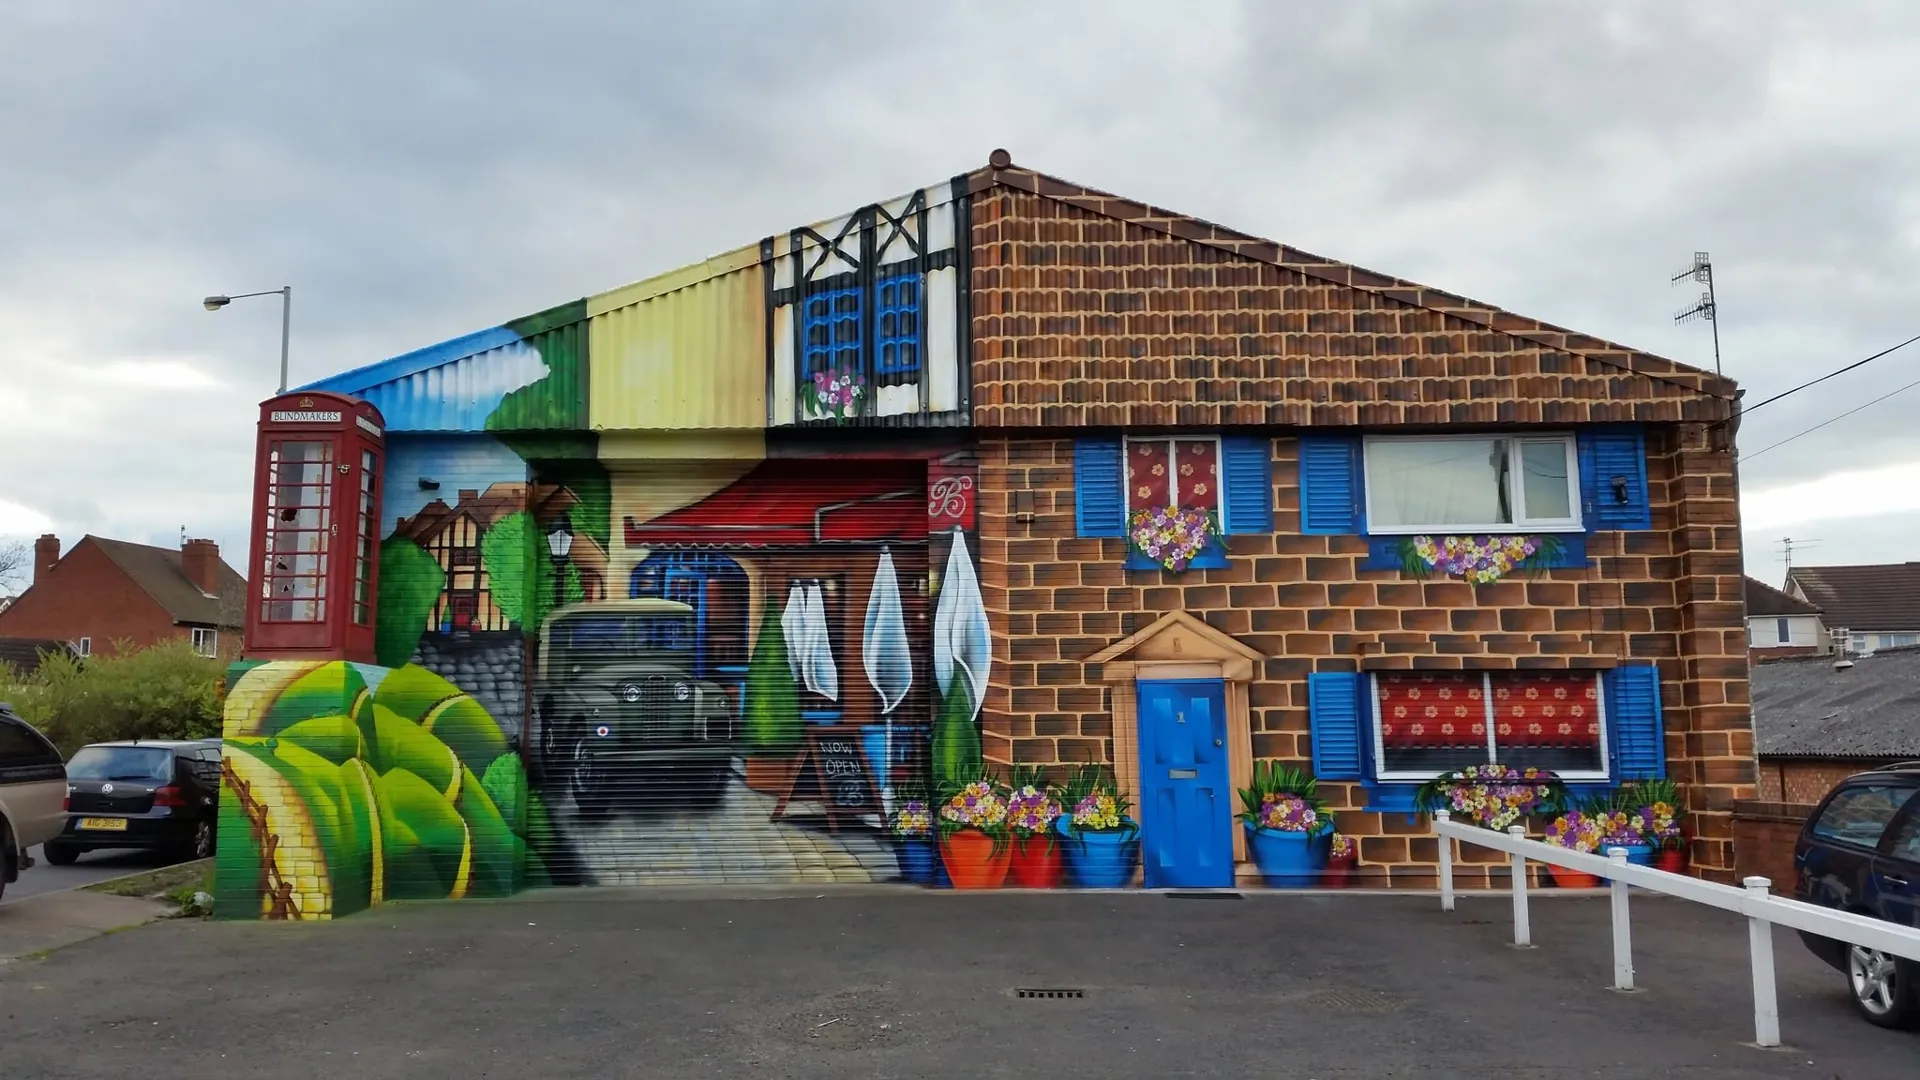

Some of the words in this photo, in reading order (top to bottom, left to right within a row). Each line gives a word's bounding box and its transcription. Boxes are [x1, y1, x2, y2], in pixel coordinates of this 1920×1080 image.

[274, 411, 338, 421] BLINDMAKERS
[928, 475, 973, 518] B
[820, 742, 853, 754] NOW
[825, 758, 862, 774] OPEN
